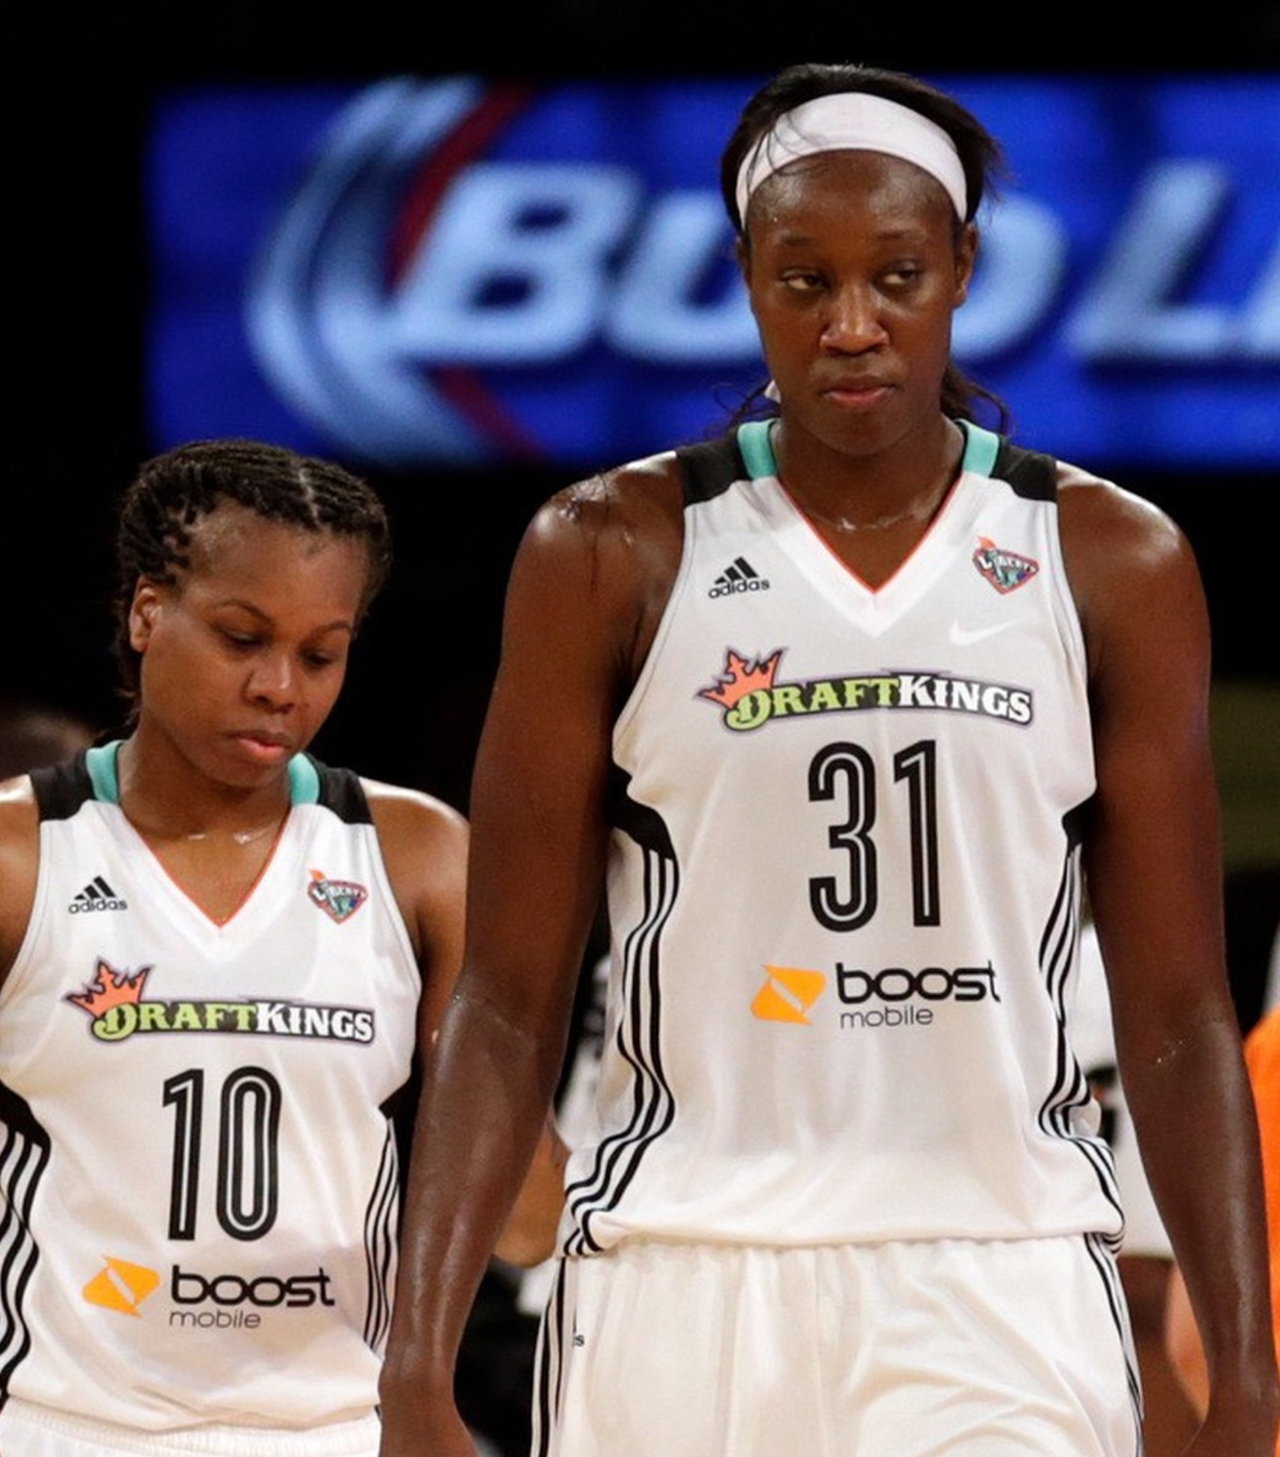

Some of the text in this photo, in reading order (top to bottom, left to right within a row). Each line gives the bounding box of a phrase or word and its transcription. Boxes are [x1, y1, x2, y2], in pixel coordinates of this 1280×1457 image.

[708, 577, 770, 598] adidas
[725, 673, 1032, 732] DRAFTKINGS
[808, 740, 941, 933] 31
[68, 897, 128, 914] adidas
[836, 960, 1001, 1004] boost
[91, 1001, 375, 1042] DRAFTKINGS
[840, 1005, 934, 1028] mobile
[162, 1066, 282, 1242] 10
[171, 1265, 336, 1307] boost
[169, 1308, 262, 1330] mobile
